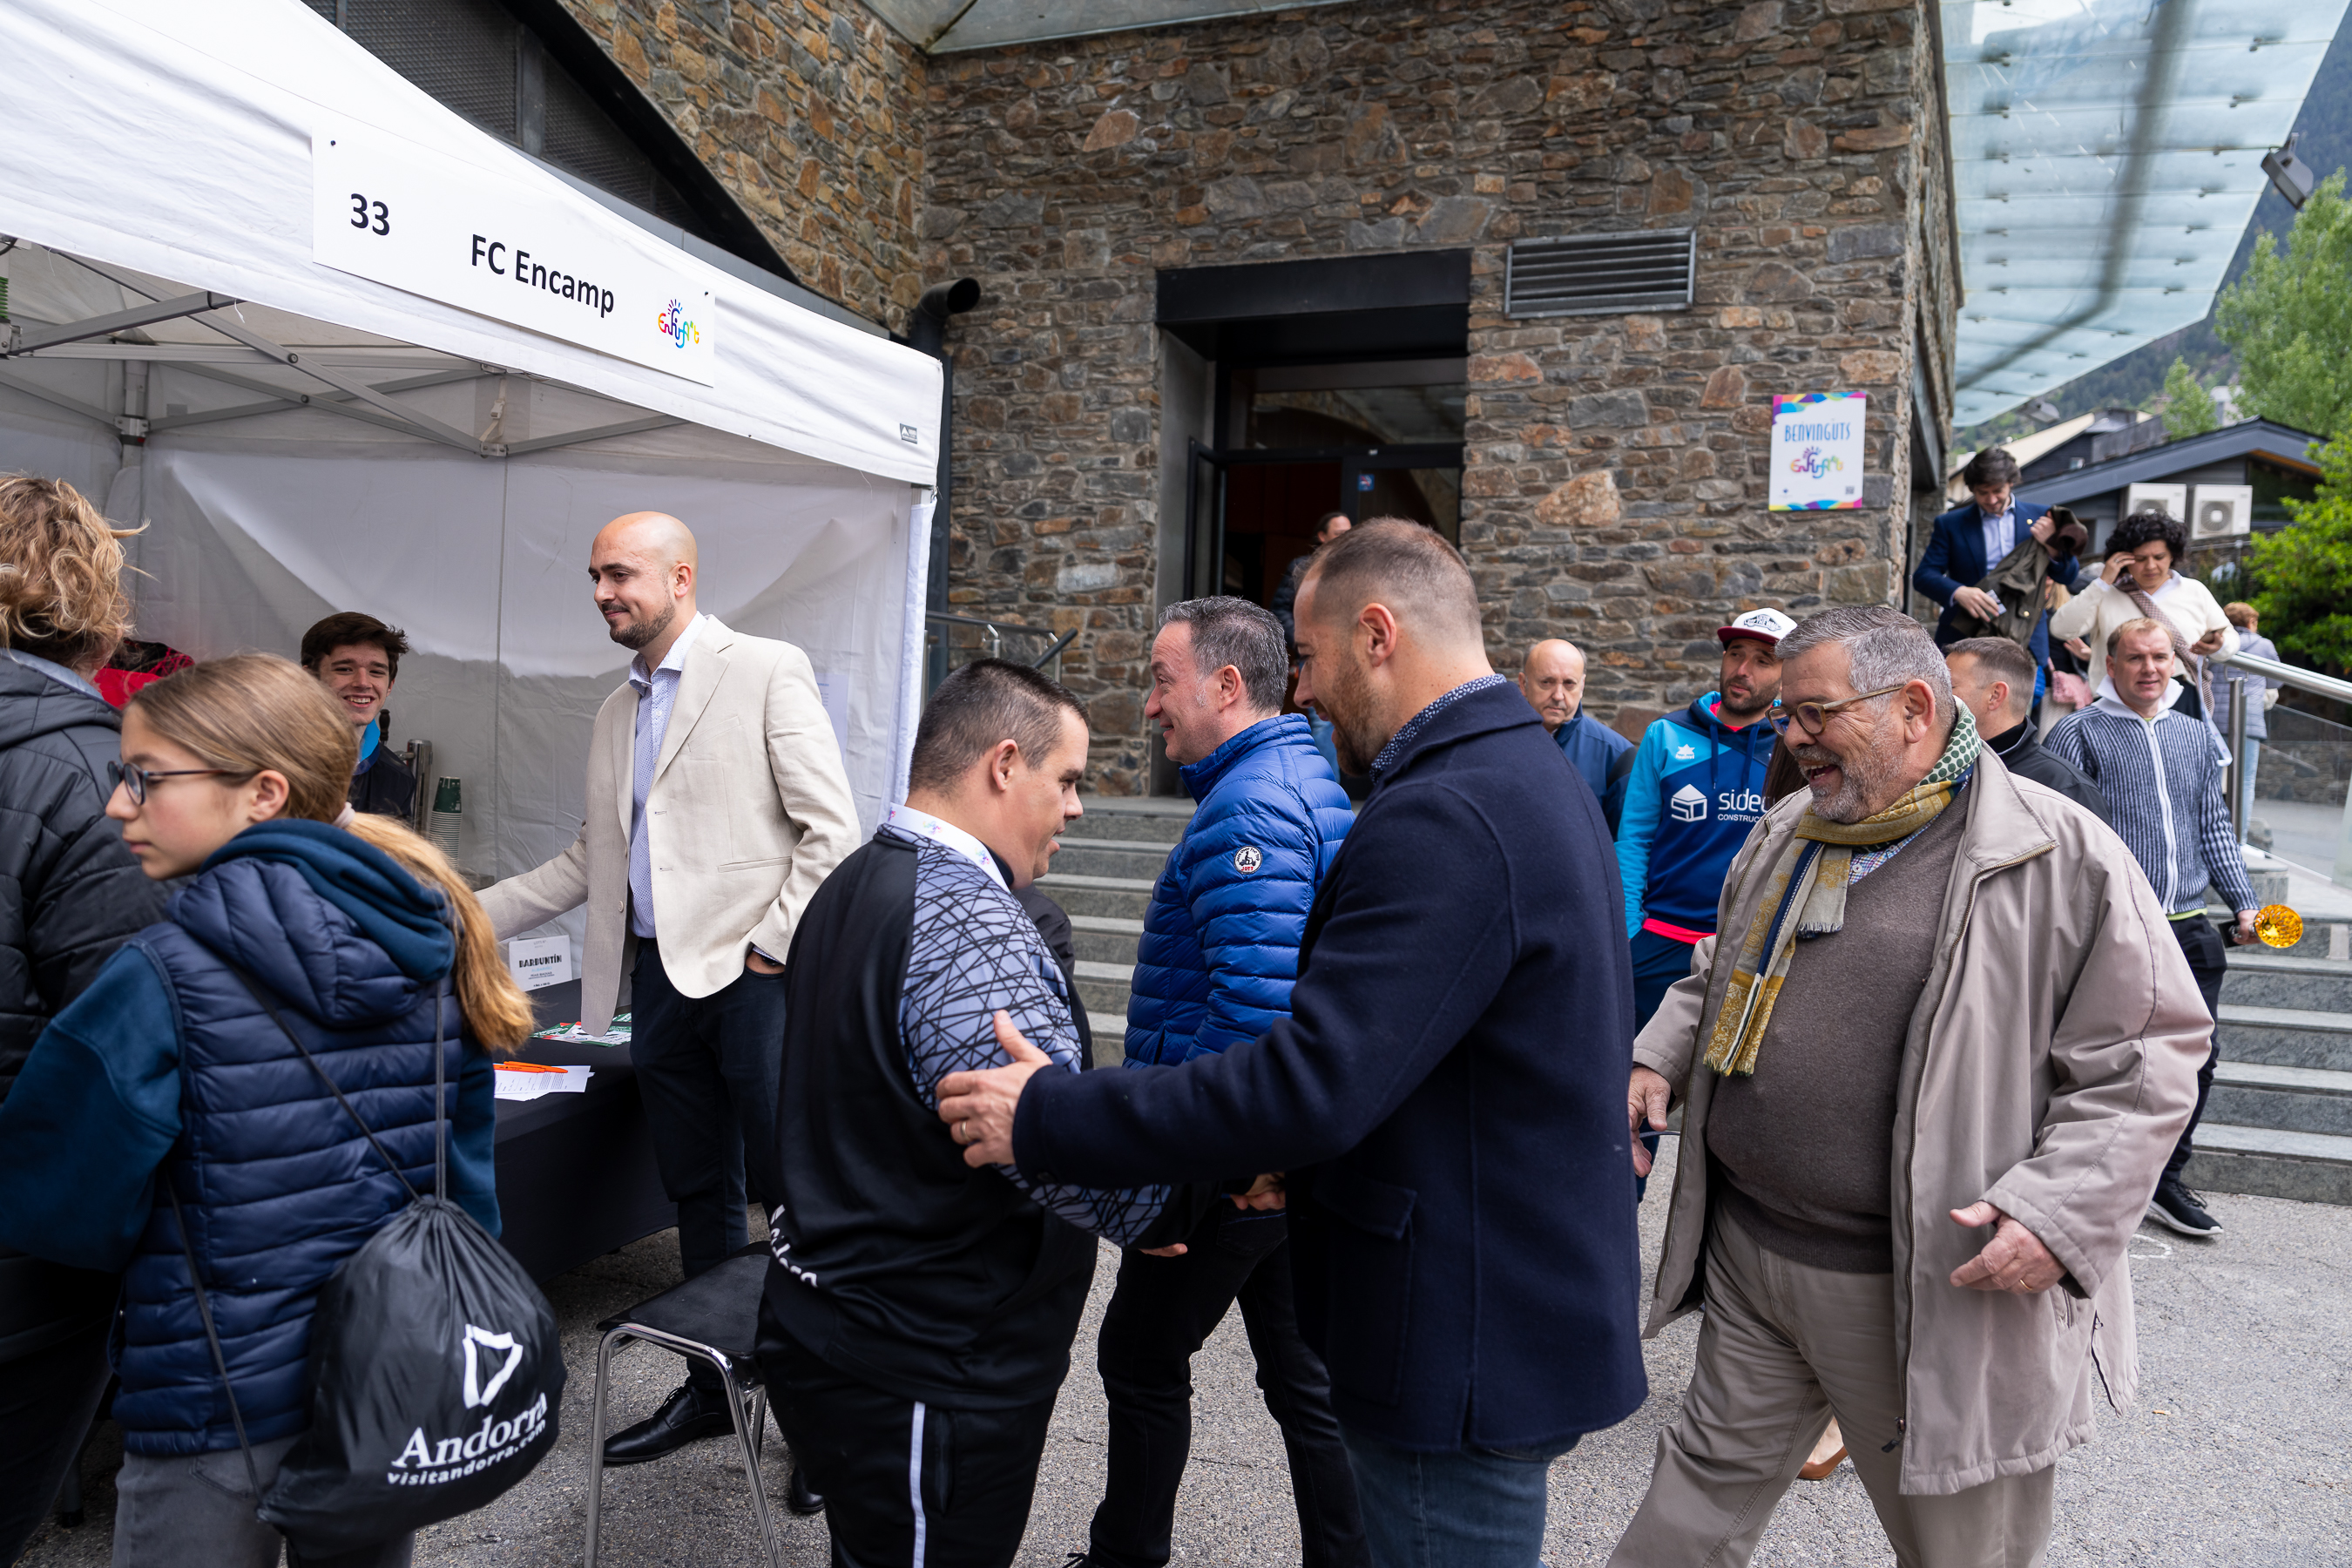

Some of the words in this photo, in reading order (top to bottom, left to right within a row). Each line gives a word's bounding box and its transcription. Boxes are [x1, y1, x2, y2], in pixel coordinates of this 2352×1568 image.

[350, 193, 390, 236] 33
[471, 233, 506, 275] FC
[515, 249, 615, 318] Encamp
[1784, 422, 1851, 443] BENVINGUTS
[1717, 814, 1762, 823] CONSTRUC
[518, 953, 563, 968] BARBUNTÍN
[391, 1392, 548, 1469] Andorra
[387, 1419, 547, 1486] visitandorra.com
